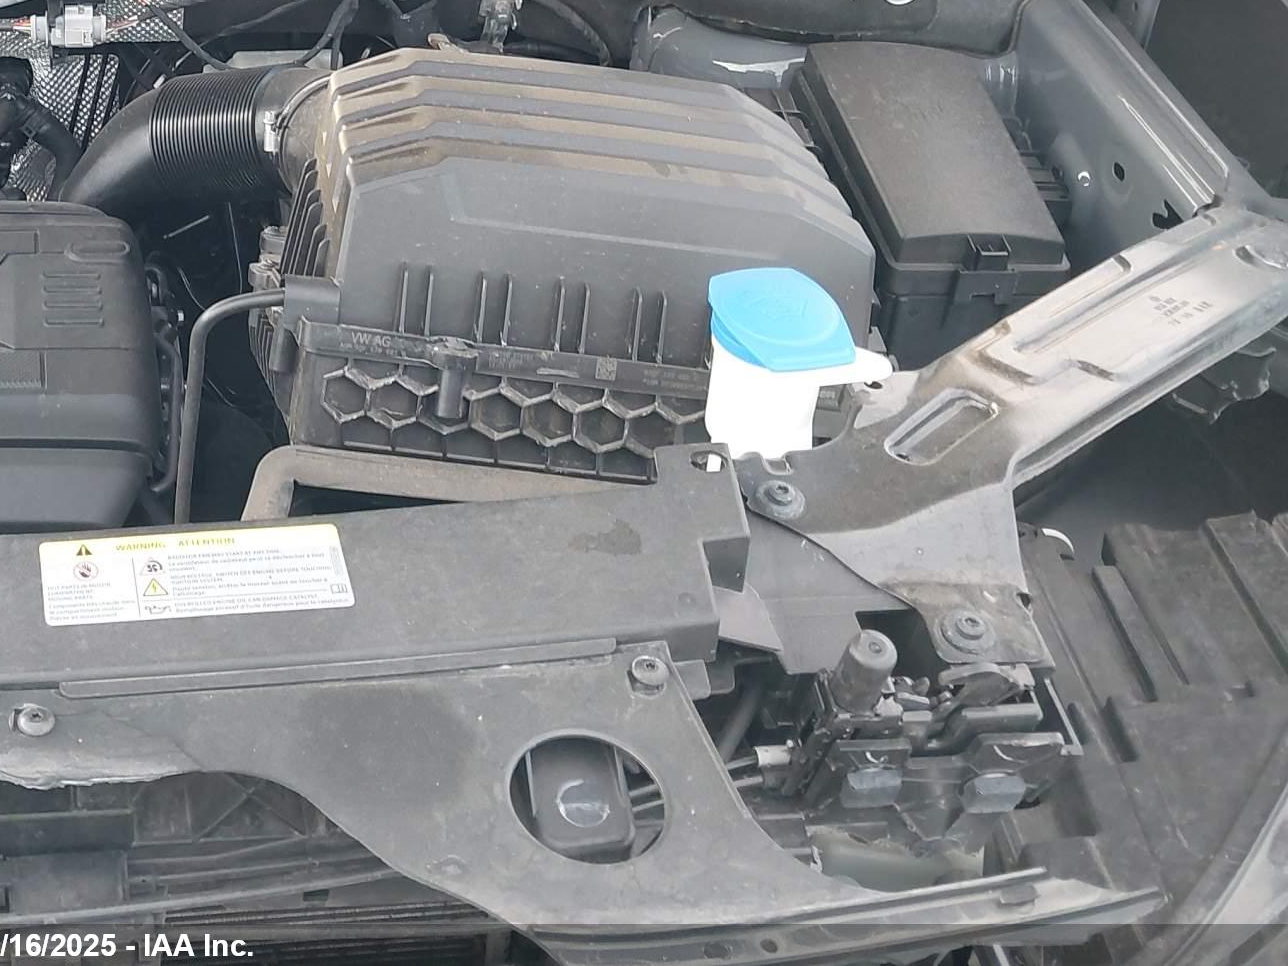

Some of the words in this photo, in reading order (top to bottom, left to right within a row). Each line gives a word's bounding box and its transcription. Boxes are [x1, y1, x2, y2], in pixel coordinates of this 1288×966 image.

[351, 331, 372, 345] VW
[373, 335, 392, 348] AG
[115, 541, 166, 551] WARNING
[177, 537, 235, 547] ATTENTION
